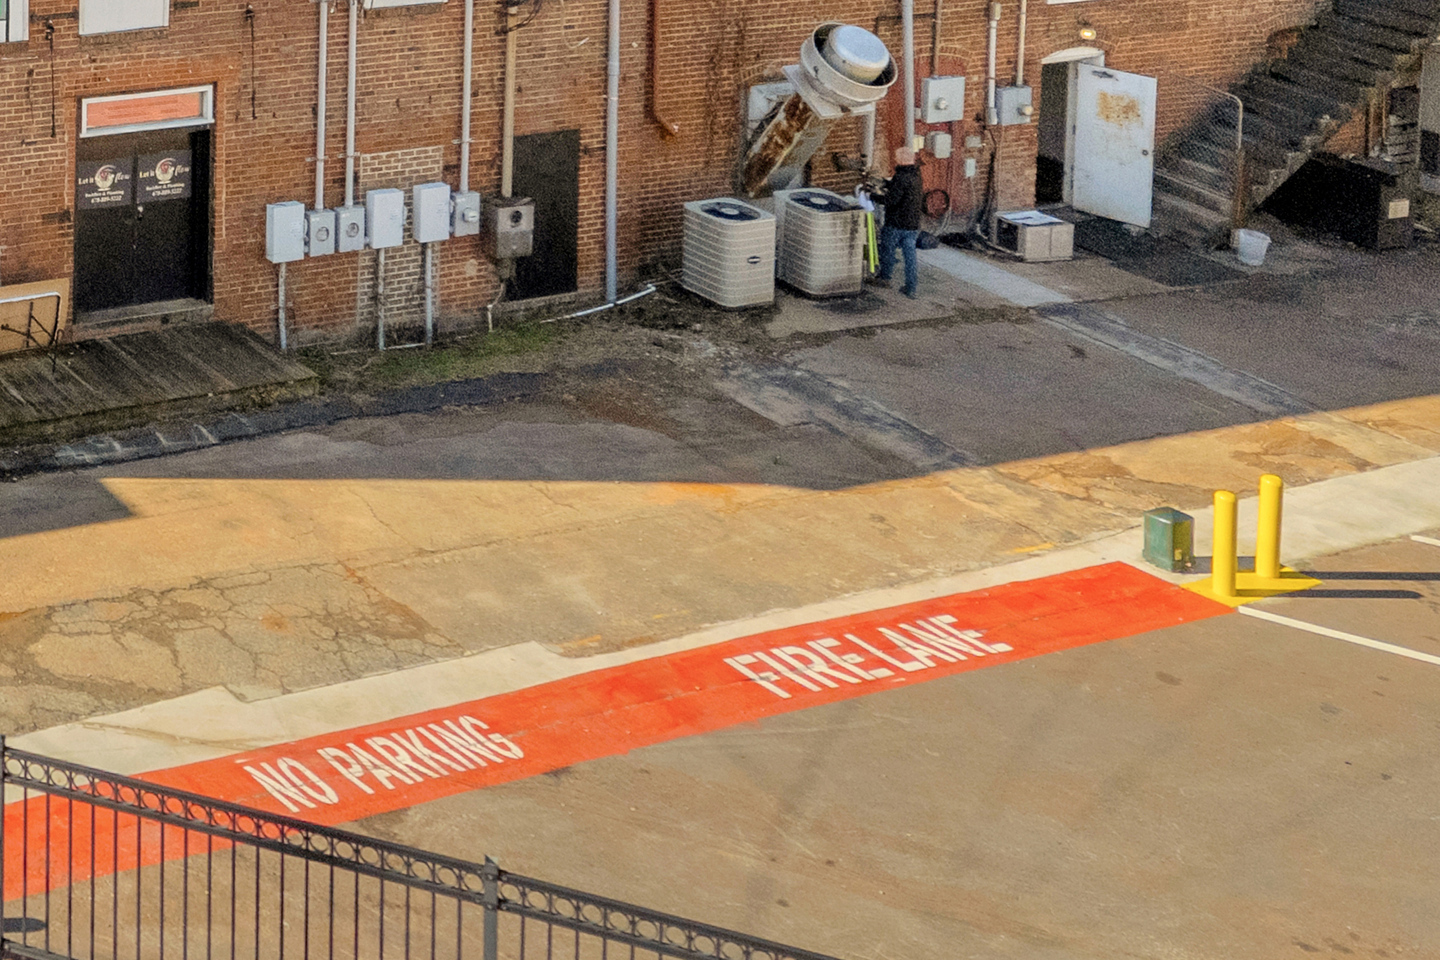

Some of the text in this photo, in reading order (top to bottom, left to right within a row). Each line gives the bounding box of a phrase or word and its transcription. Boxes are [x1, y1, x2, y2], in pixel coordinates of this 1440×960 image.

[723, 614, 1014, 699] FIRE LANE
[243, 715, 524, 813] NO PARKING
